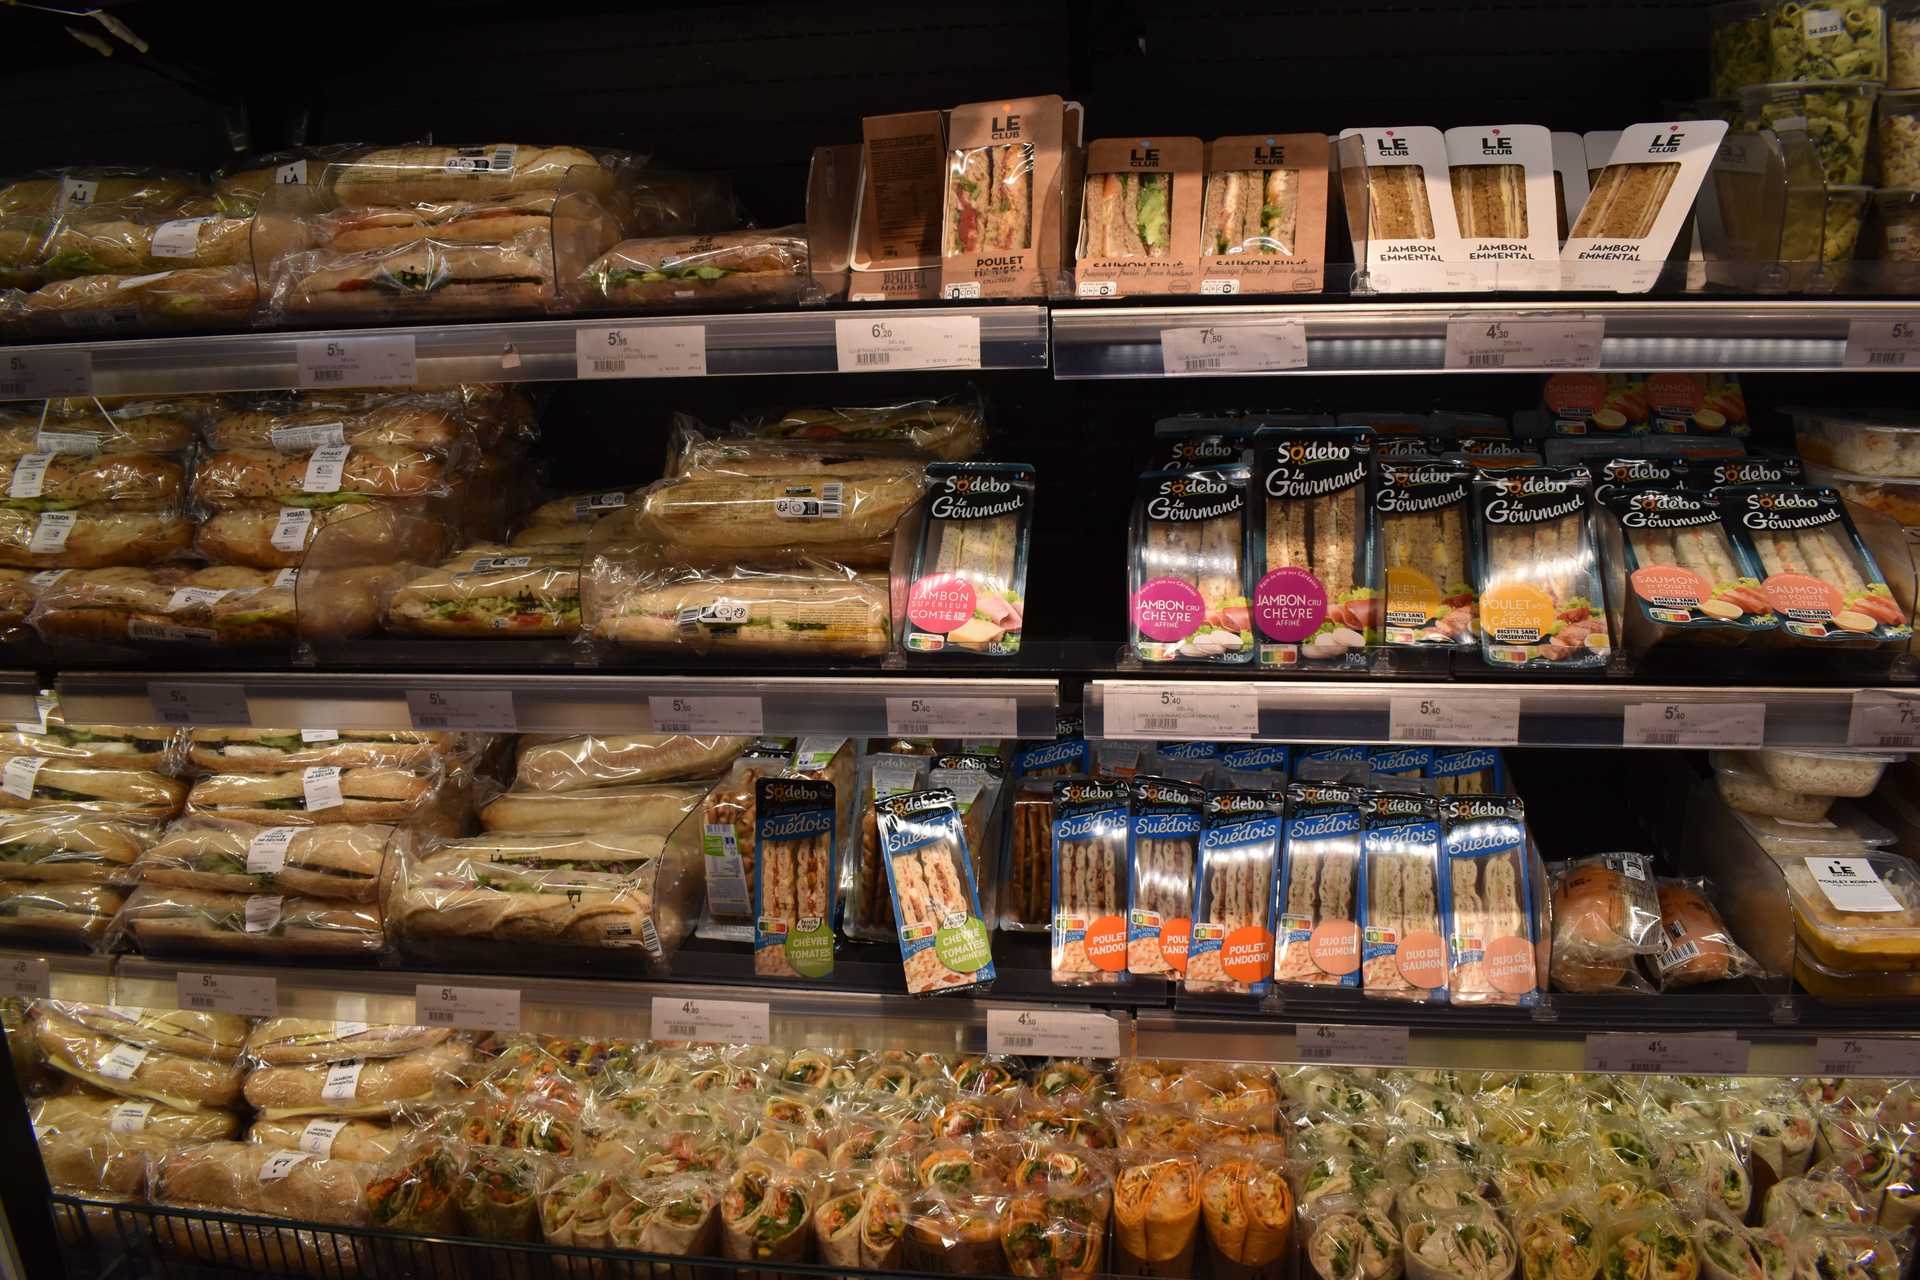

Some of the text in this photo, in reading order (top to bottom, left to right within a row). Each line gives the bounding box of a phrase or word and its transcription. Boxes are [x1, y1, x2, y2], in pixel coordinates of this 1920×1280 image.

[992, 116, 1020, 132] LE
[992, 132, 1019, 140] CLUB
[1482, 137, 1513, 150] LE
[1650, 134, 1685, 147] LE
[1254, 146, 1285, 159] LE
[1378, 138, 1409, 151] LE
[1130, 148, 1160, 161] LE
[1386, 245, 1436, 253] JAMBON
[1476, 244, 1527, 252] JAMBON
[1589, 243, 1640, 252] JAMBON
[977, 256, 1023, 267] POULET
[1381, 253, 1444, 262] EMMENTAL
[1469, 252, 1535, 261] EMMENTAL
[1578, 252, 1641, 261] EMMENTAL
[1172, 442, 1231, 458] Sodebo
[1277, 441, 1350, 464] Sodebo
[1266, 462, 1367, 497] Gourmand
[1603, 464, 1670, 481] Sodebo
[1714, 465, 1781, 483] Sodebo
[945, 475, 1010, 494] Sodebo
[1160, 480, 1227, 496] Sodebo
[1496, 477, 1566, 496] Sodebo
[1377, 485, 1467, 511] Gourmand
[1630, 493, 1701, 511] Sodebo
[1747, 493, 1818, 510] Sodebo
[931, 495, 1024, 518] Gourmand
[1148, 494, 1244, 521] Gourmand
[1486, 494, 1584, 523] Gourmand
[1622, 511, 1721, 527] Gourmand
[1743, 508, 1841, 529] Gourmand
[1637, 575, 1699, 585] SAUMON
[914, 591, 969, 602] JAMBON
[1767, 585, 1830, 594] SAUMON
[1136, 600, 1200, 612] JAMBON CRU
[1256, 594, 1306, 606] JAMBON
[1389, 601, 1426, 609] AESAR
[1483, 600, 1530, 610] POULET
[910, 610, 951, 620] COMTÉ
[1490, 616, 1541, 626] CAESAR
[1223, 653, 1244, 663] 190g
[1023, 743, 1084, 768] Suédois
[1224, 750, 1284, 770] Suédois
[1368, 751, 1429, 772] Suédois
[1433, 752, 1495, 775] Suédois
[765, 784, 818, 800] Sodebo
[1061, 785, 1113, 802] Sodebo
[1138, 784, 1189, 804] Sodebo
[1211, 795, 1264, 812] Sodebo
[1368, 799, 1421, 815] Sodebo
[1449, 801, 1505, 818] Sodebo
[762, 813, 831, 838] Suédois
[1058, 812, 1127, 838] Suédois
[1136, 816, 1201, 834] Suédois
[1291, 813, 1360, 838] Suédois
[1205, 821, 1276, 848] Suédois
[1366, 826, 1436, 849] Suédois
[1828, 866, 1855, 874] LE
[1093, 932, 1127, 945] POULET
[1167, 935, 1189, 944] POUL
[1320, 936, 1354, 946] DUO DE
[1229, 943, 1265, 955] POULET
[1406, 948, 1440, 959] DUO DE
[1223, 953, 1269, 966] TANDOORI
[1403, 960, 1444, 971] SAUMON
